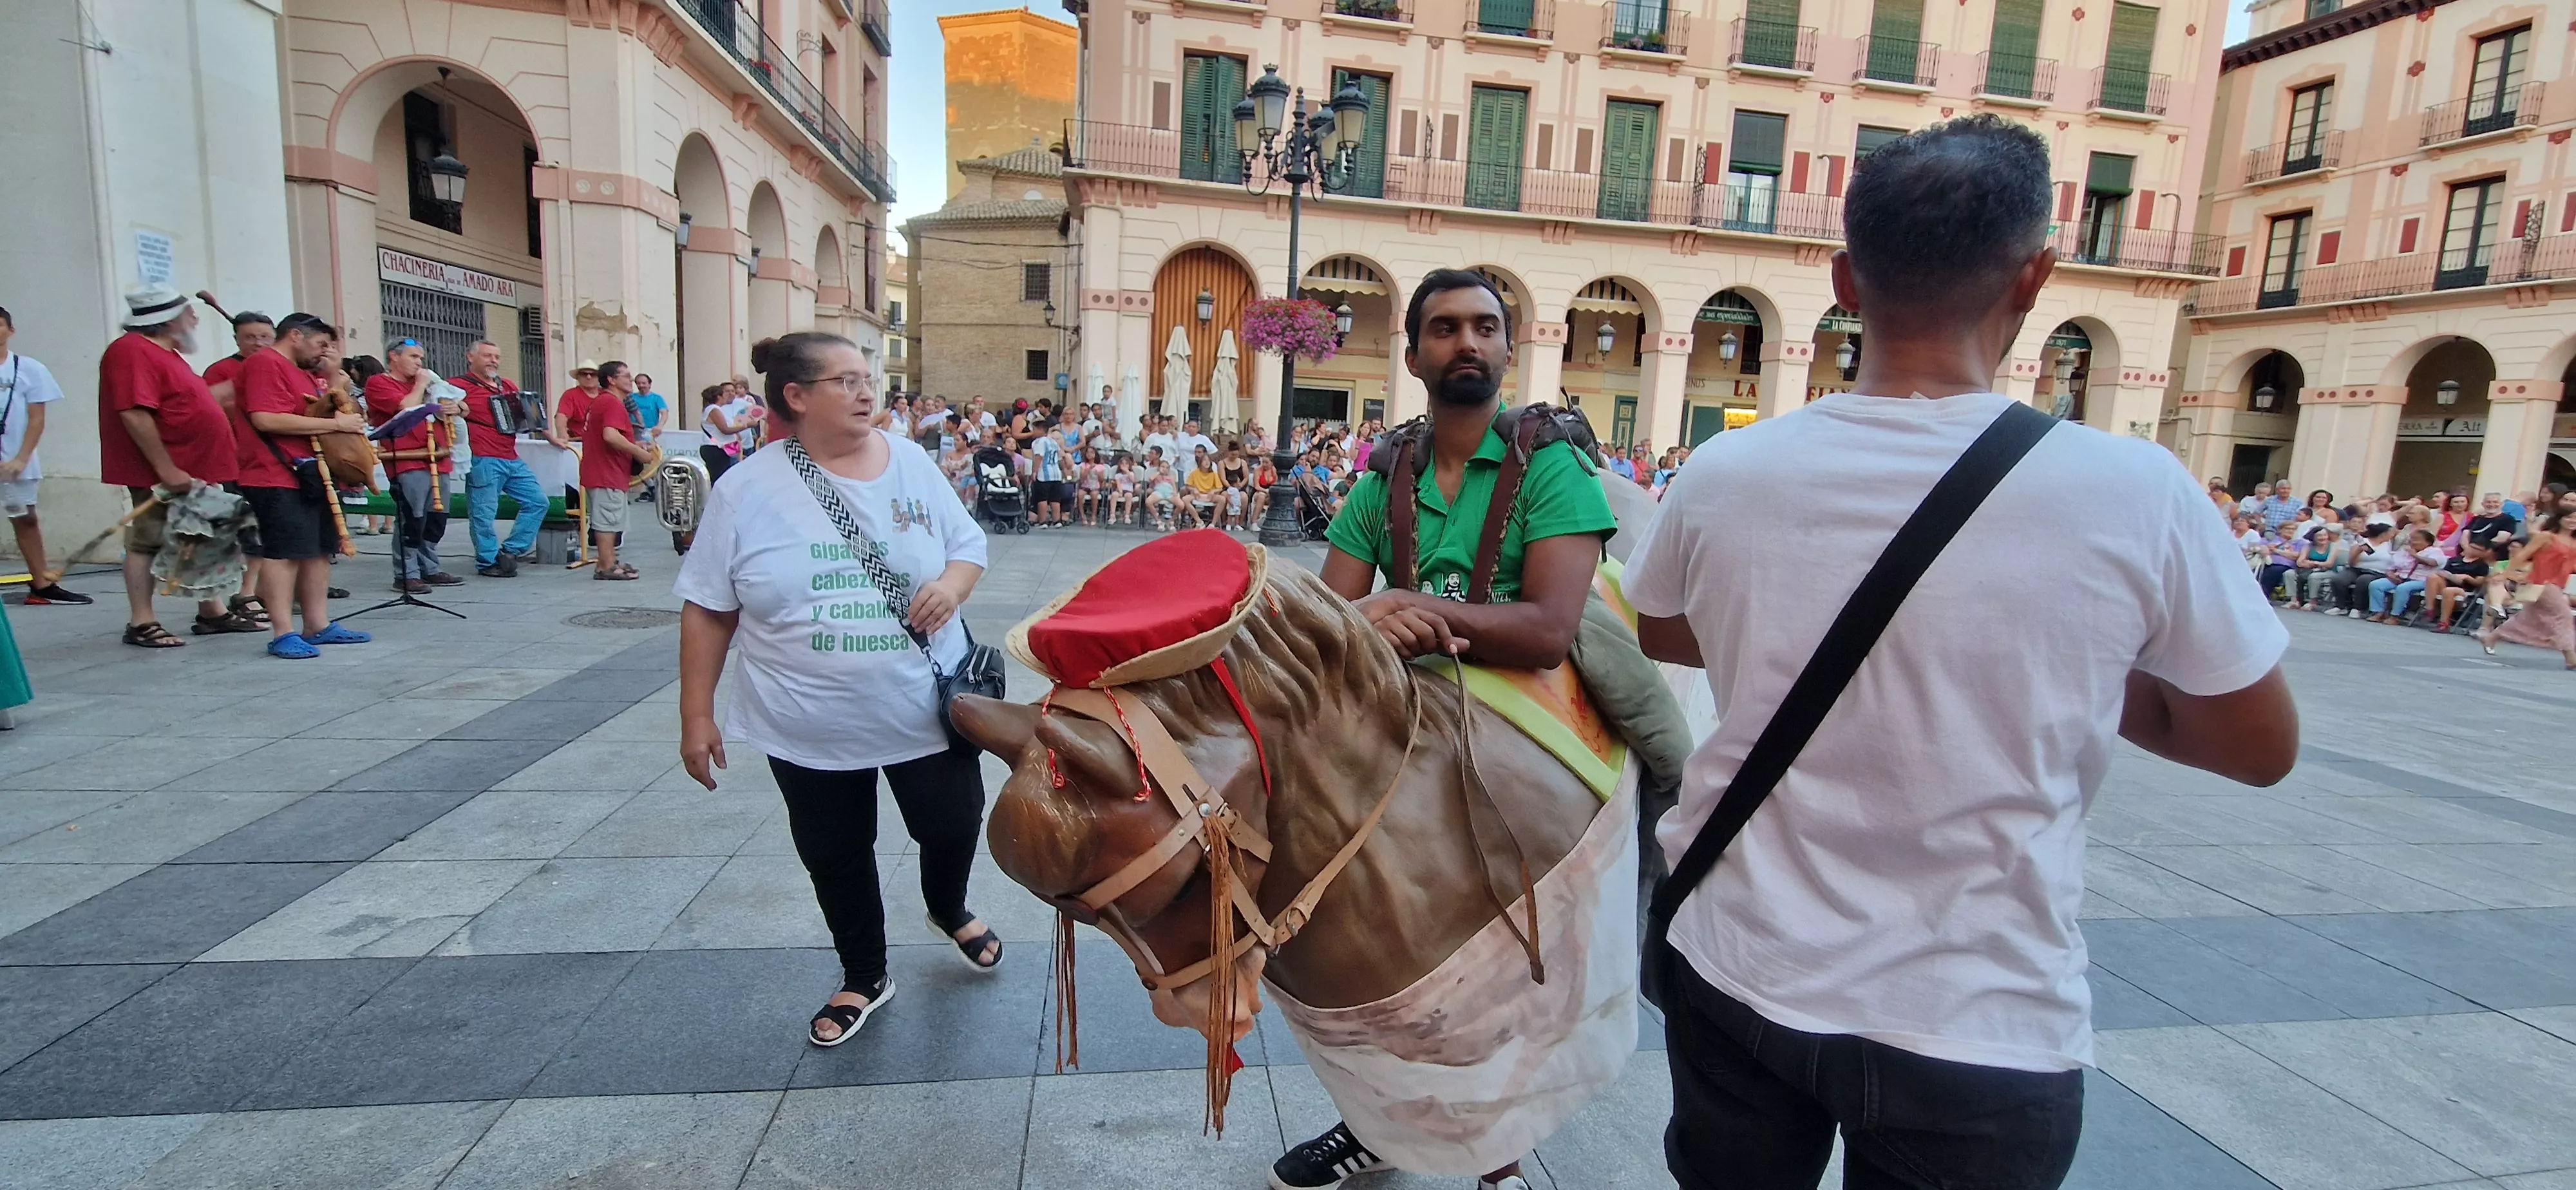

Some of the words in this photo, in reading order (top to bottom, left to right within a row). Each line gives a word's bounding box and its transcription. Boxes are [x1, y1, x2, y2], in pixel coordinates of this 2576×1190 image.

[383, 252, 445, 282] CHACINERIA
[463, 272, 494, 292] AMADO
[497, 280, 513, 297] ARA
[1832, 319, 1839, 330] LA
[1839, 320, 1862, 332] CONFIANZ
[1685, 377, 1705, 388] INOS
[1734, 380, 1757, 397] LA
[810, 541, 889, 561] Gigaes
[811, 571, 911, 590] cabezos
[811, 605, 824, 622] y
[811, 631, 836, 652] de
[842, 632, 909, 652] huesca
